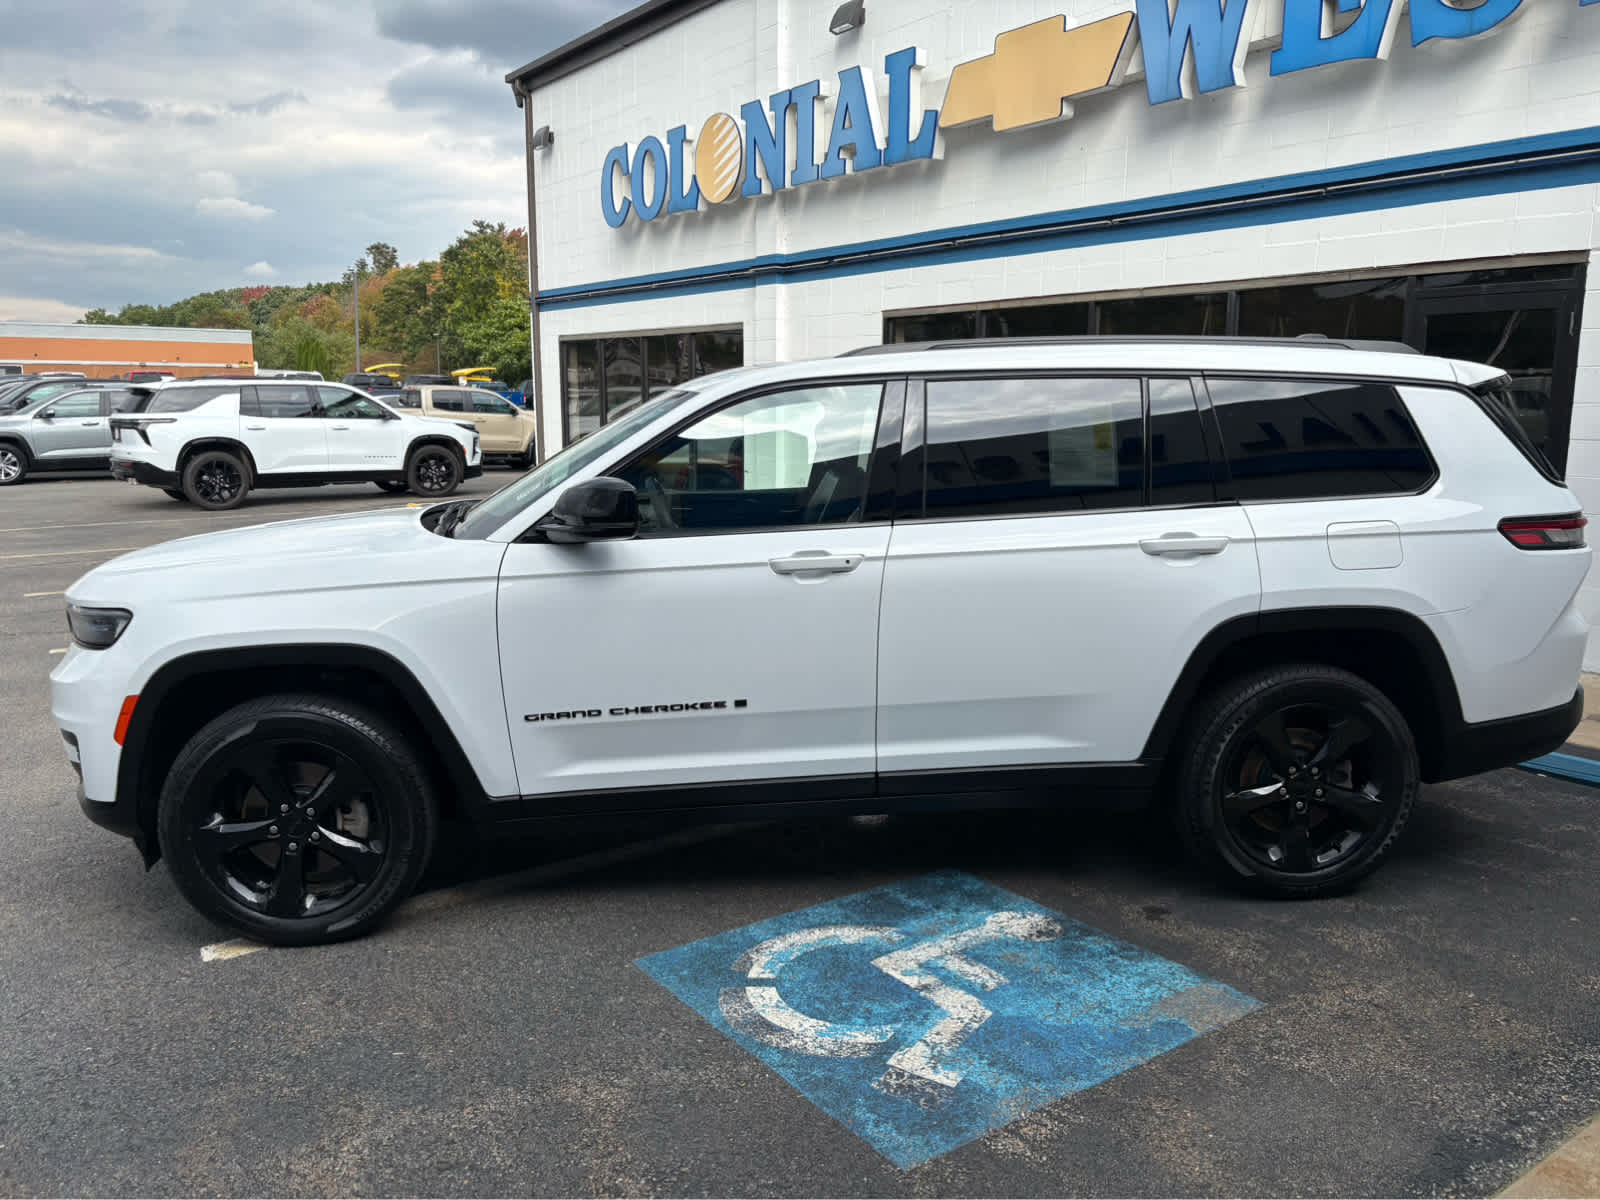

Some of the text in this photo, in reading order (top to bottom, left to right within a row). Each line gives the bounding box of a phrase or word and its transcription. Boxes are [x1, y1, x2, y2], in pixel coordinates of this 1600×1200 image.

[601, 46, 940, 229] COLONIAL
[524, 709, 603, 722] GRAND
[609, 700, 727, 716] CHEROKEE
